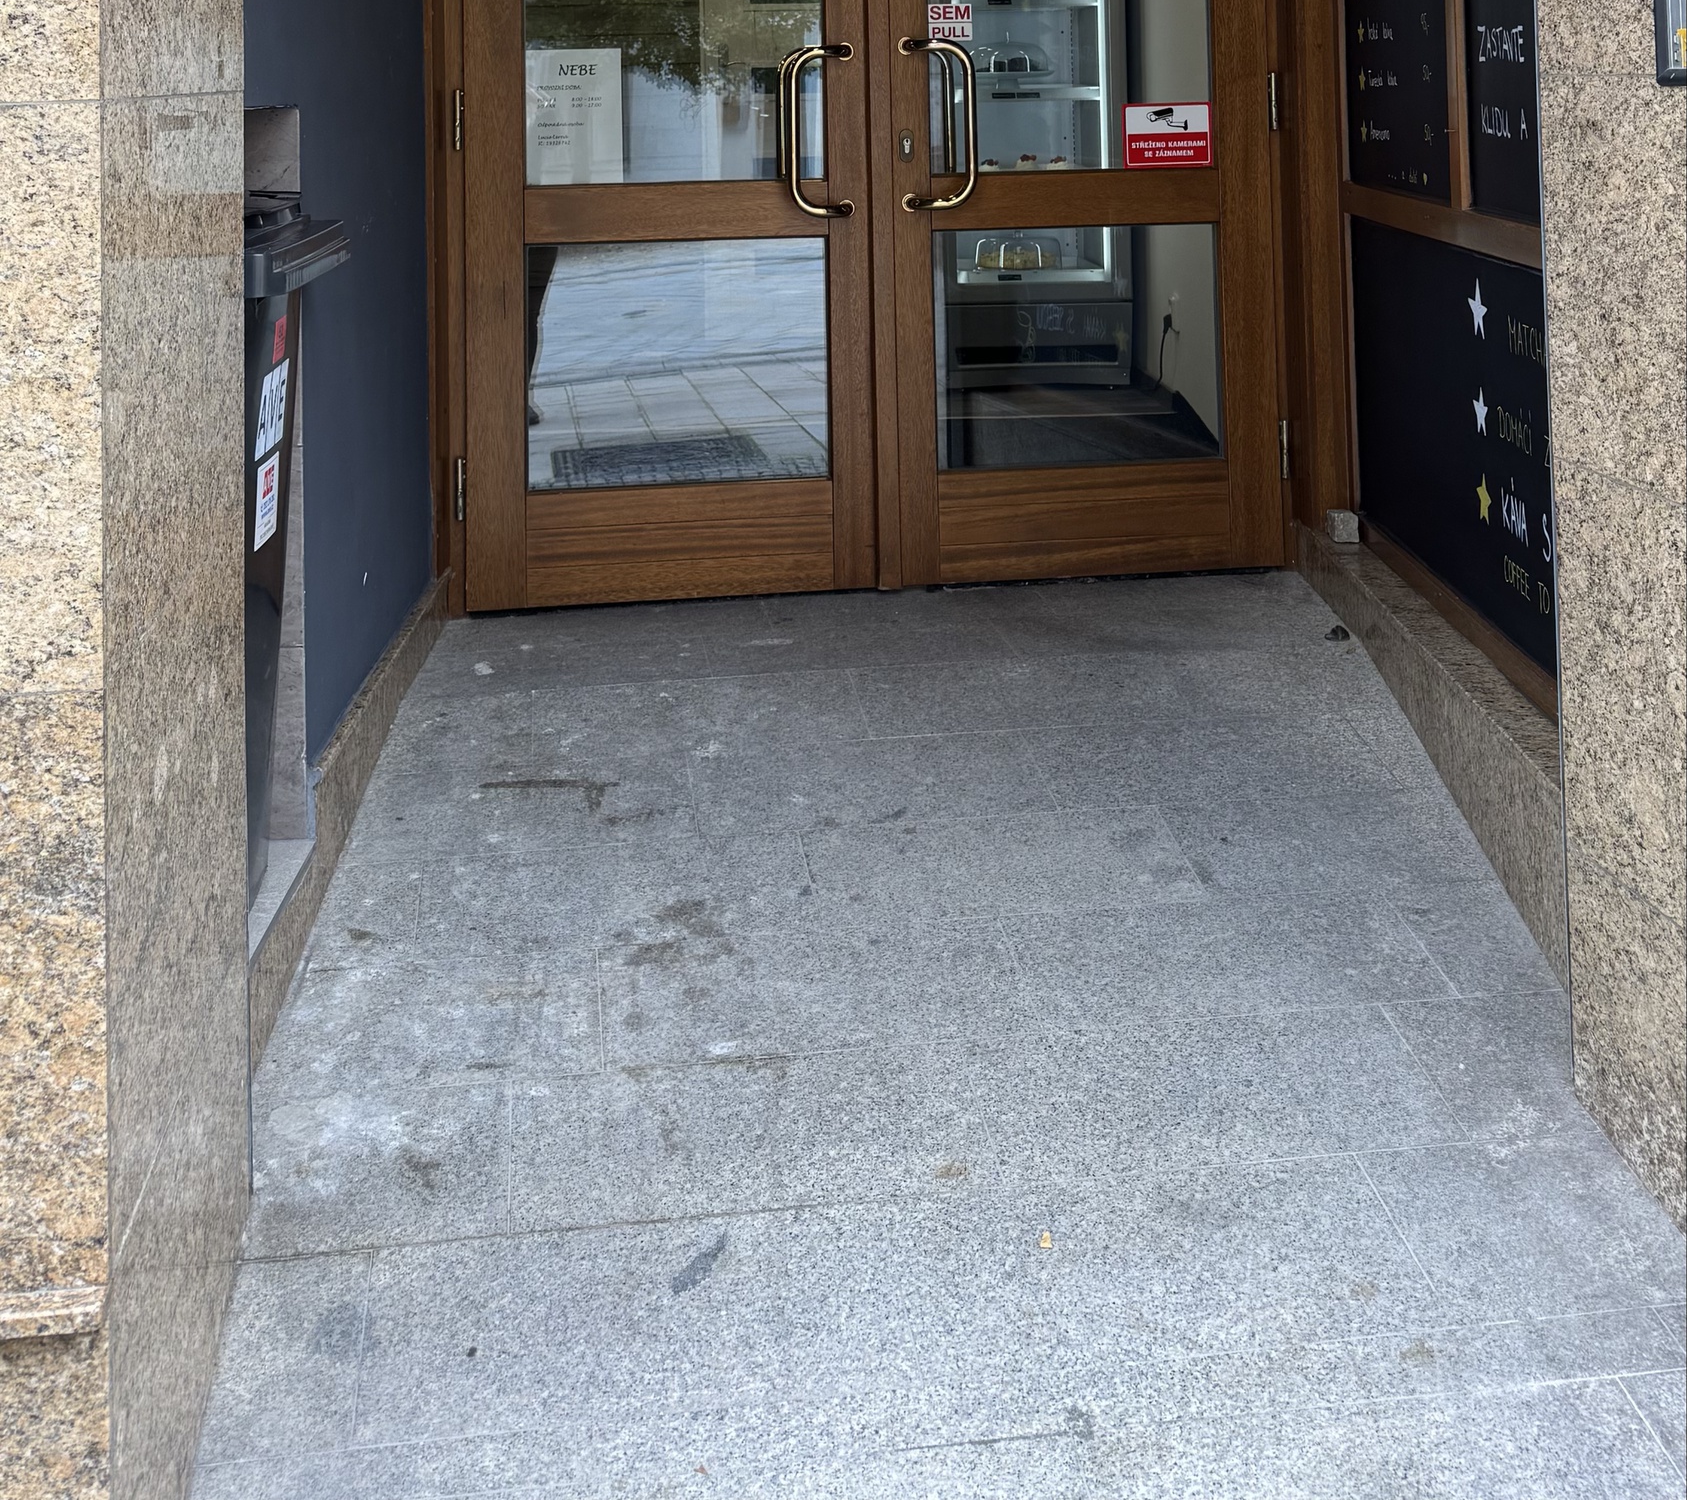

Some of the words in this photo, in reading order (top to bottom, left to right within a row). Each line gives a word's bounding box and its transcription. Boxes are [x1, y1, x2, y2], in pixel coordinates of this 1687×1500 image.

[929, 5, 971, 20] SEM
[931, 26, 970, 38] PULL
[558, 63, 598, 76] NEBE
[1520, 108, 1528, 140] A
[1131, 140, 1166, 149] STŘEŽENO
[1168, 140, 1206, 148] KAMERAMI
[1155, 149, 1194, 157] ZÁZNAMEM
[257, 378, 286, 440] AVE
[1497, 407, 1533, 457] DOMÁCÍ
[1501, 476, 1529, 547] KÁVA
[1503, 554, 1531, 601] COFFEE
